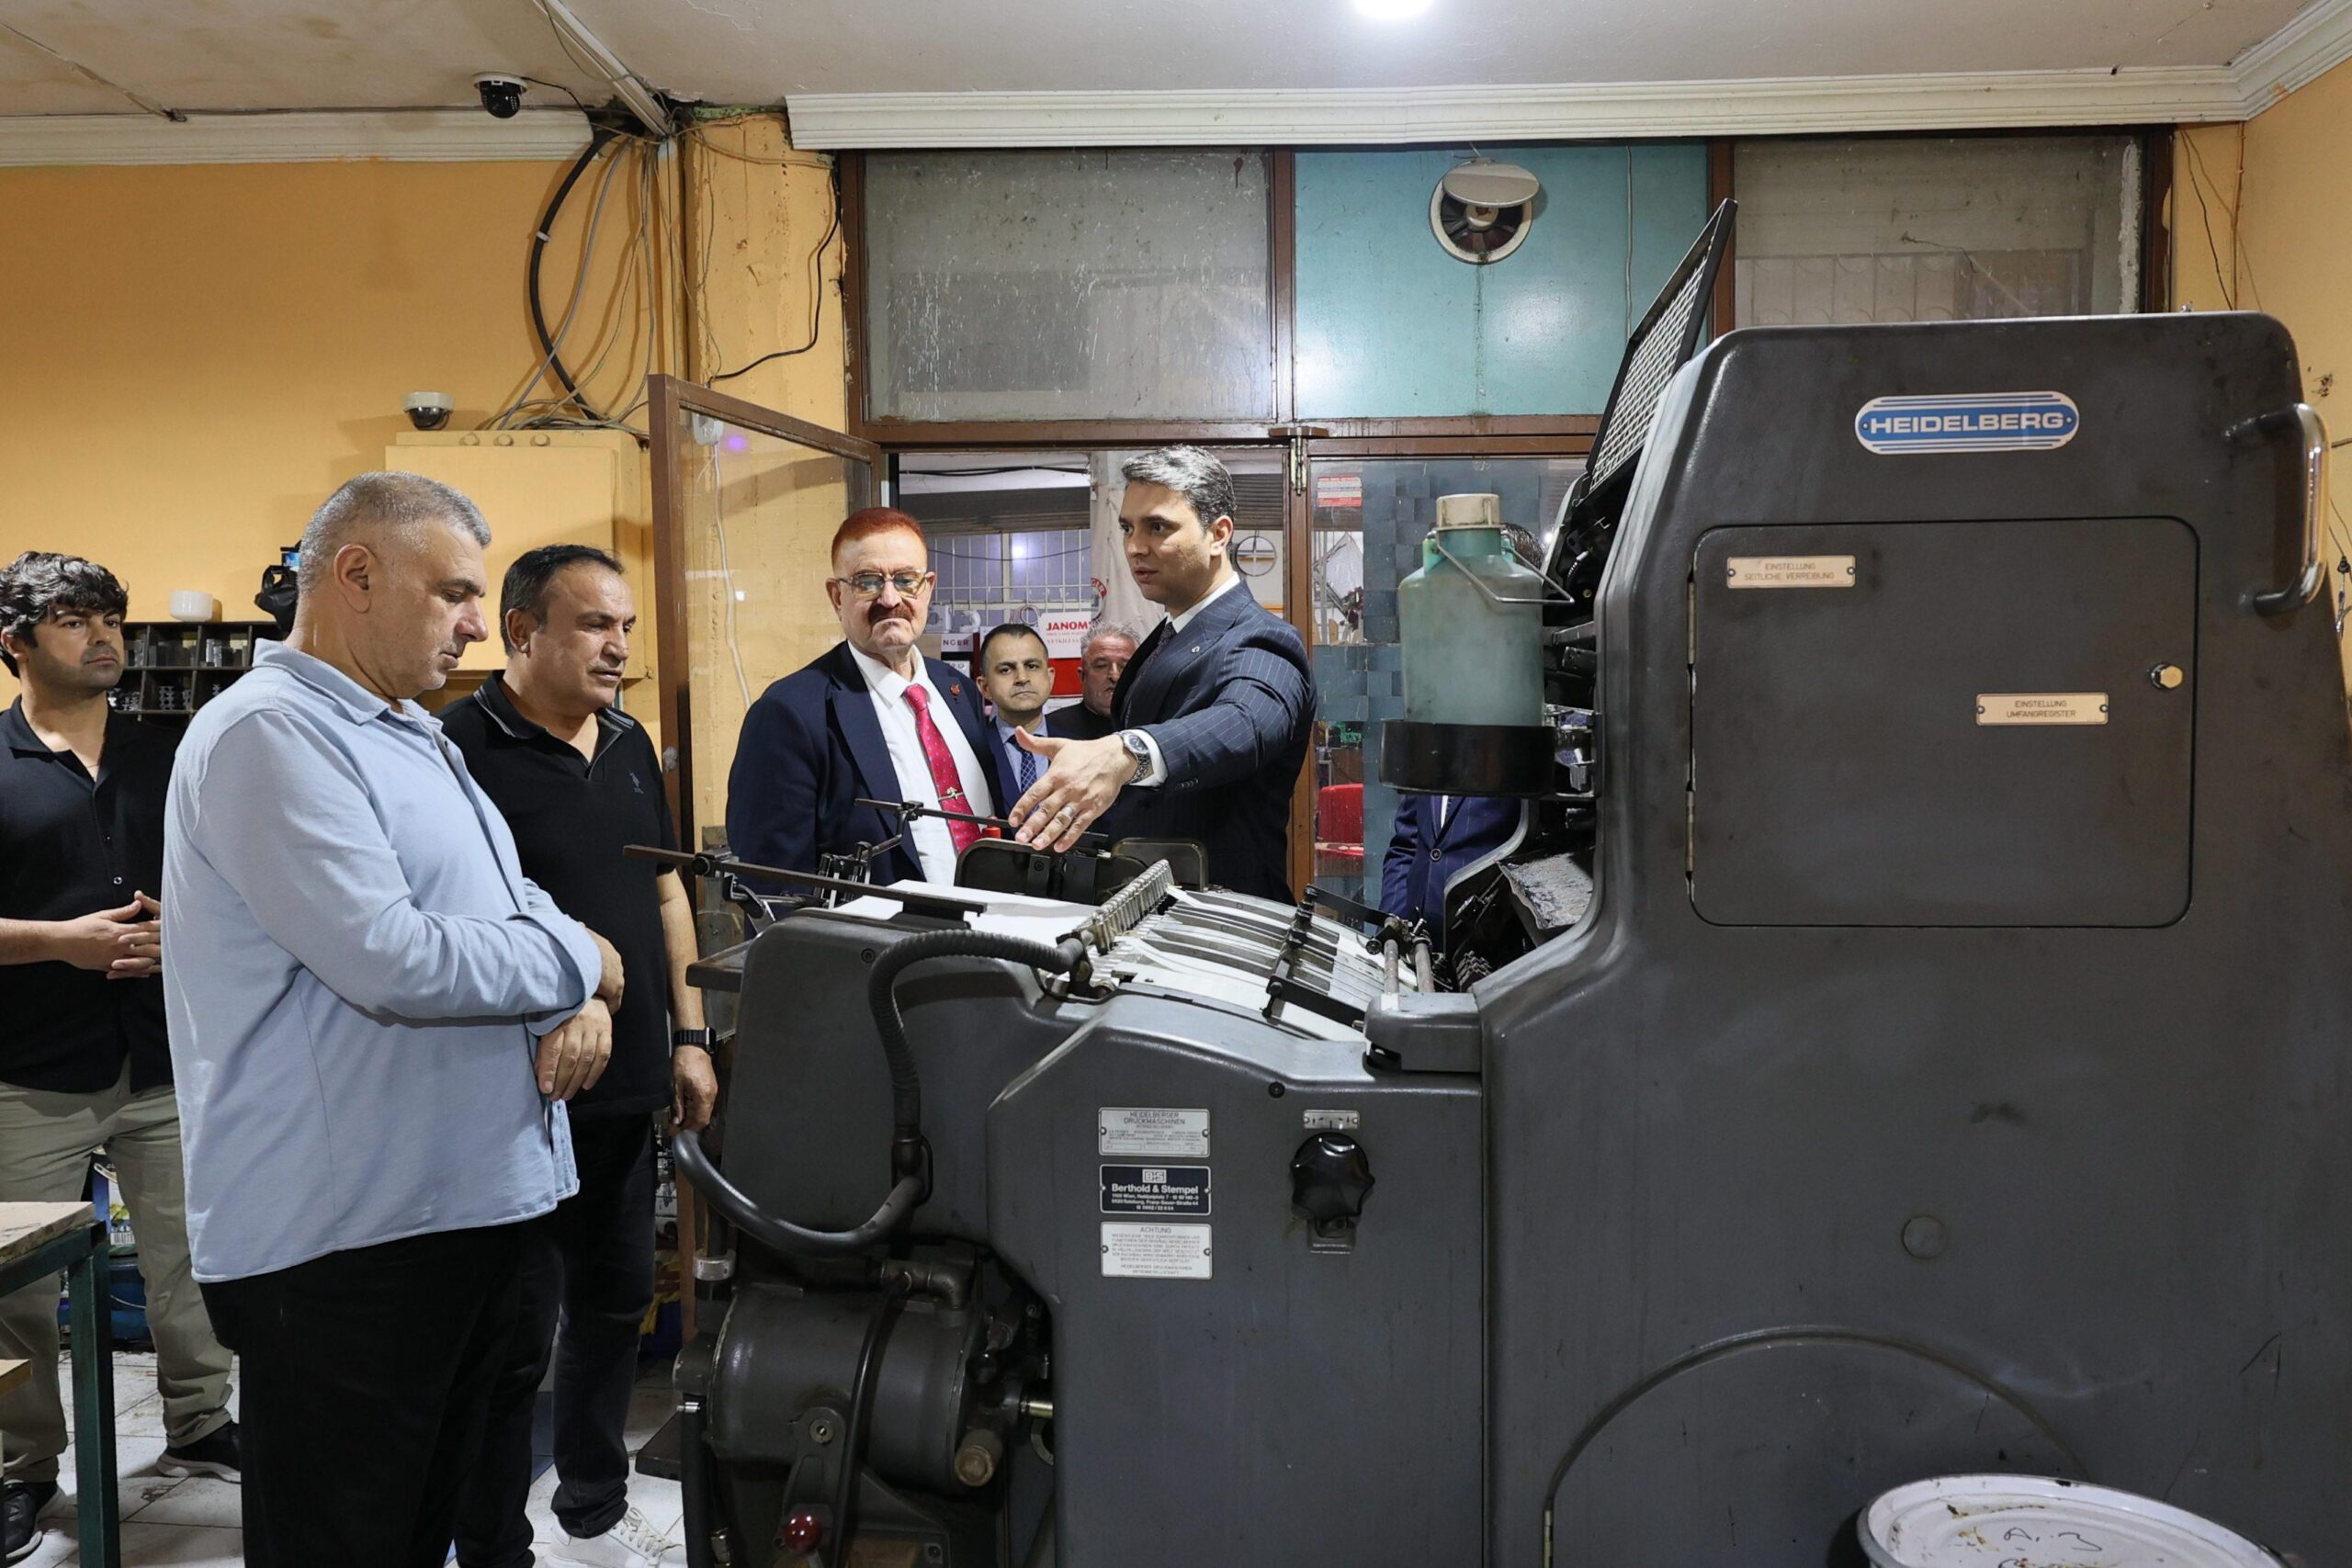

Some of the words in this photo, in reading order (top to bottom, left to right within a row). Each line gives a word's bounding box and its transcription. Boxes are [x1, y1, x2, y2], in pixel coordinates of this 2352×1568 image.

[1870, 412, 2064, 434] HEIDELBERG
[1765, 562, 1815, 570] EINSTELLUNG
[1744, 572, 1781, 581] SEITLICHE
[1112, 1183, 1150, 1192] Berthold
[1161, 1185, 1199, 1195] Stempel
